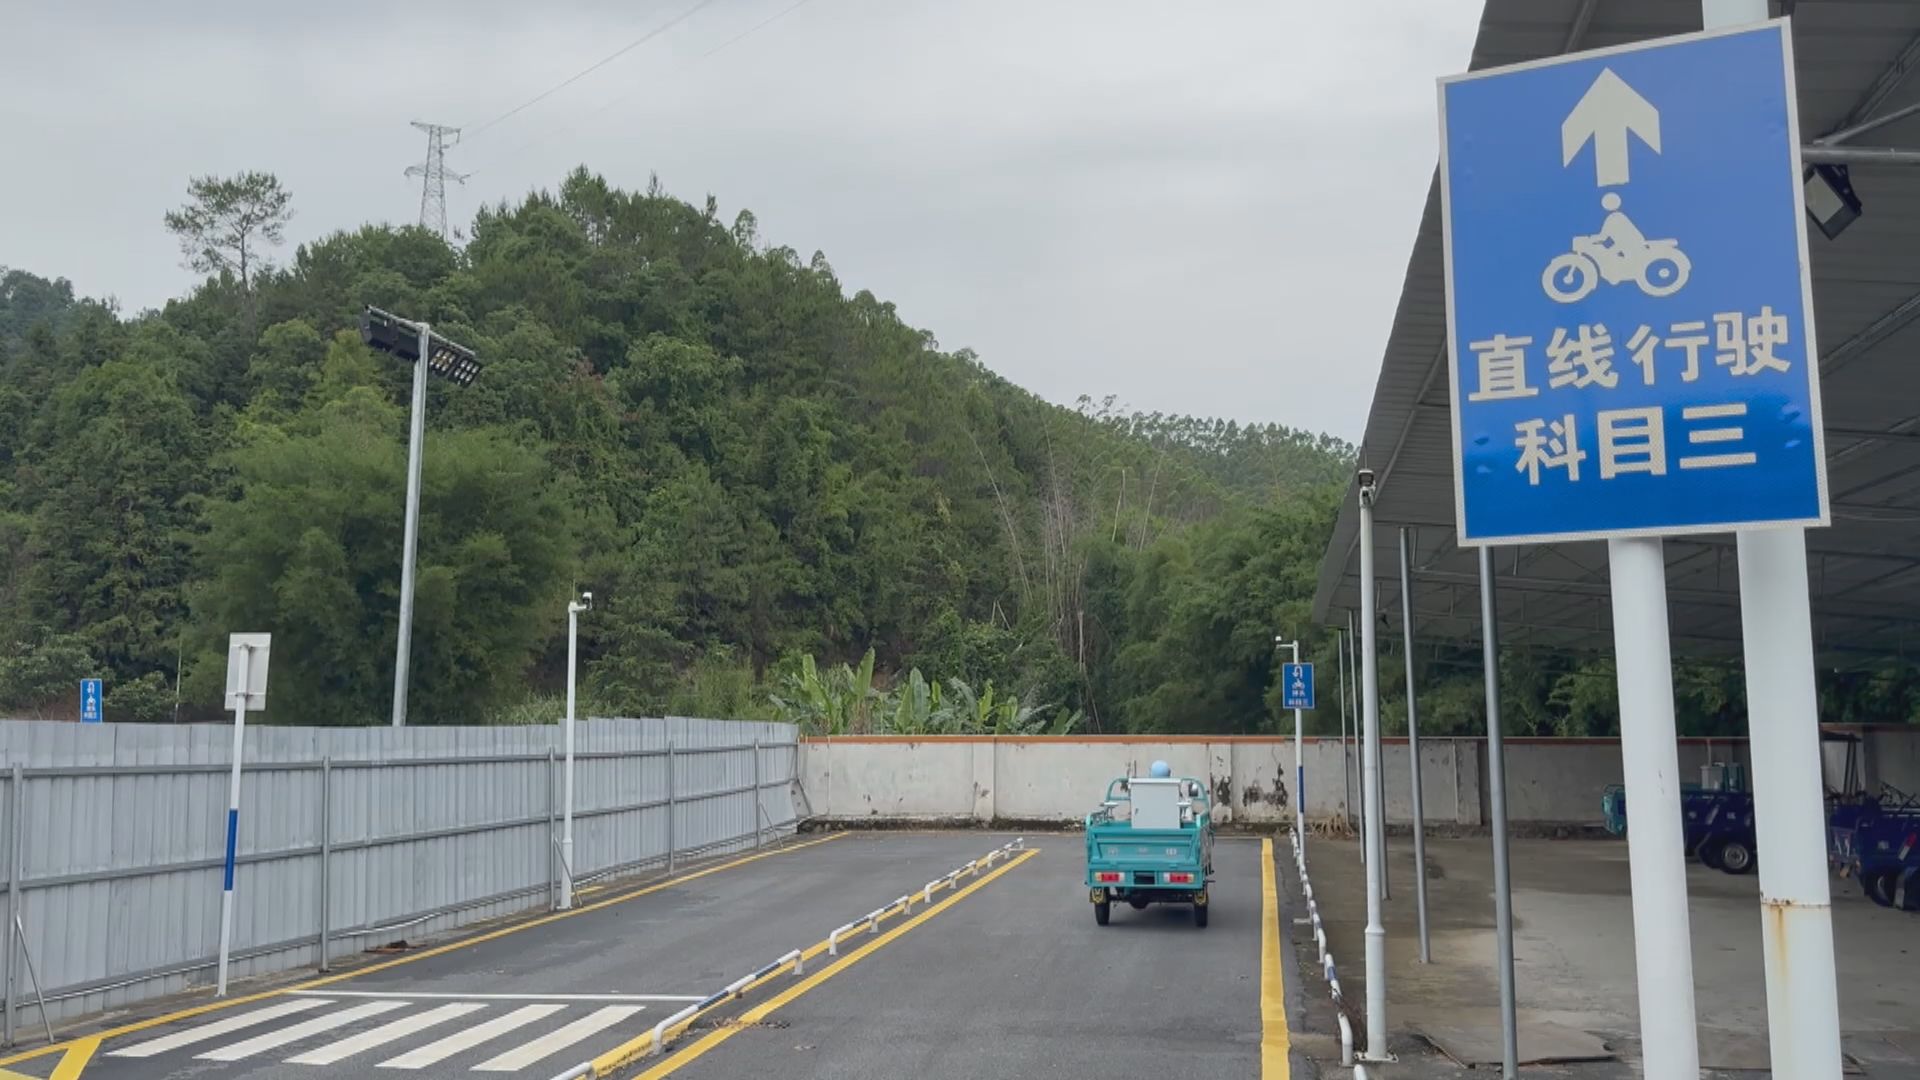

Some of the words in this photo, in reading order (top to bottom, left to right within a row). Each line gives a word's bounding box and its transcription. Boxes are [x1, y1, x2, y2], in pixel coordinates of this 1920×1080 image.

[1468, 306, 1792, 402] 直线行驶
[1514, 403, 1757, 486] 科目三
